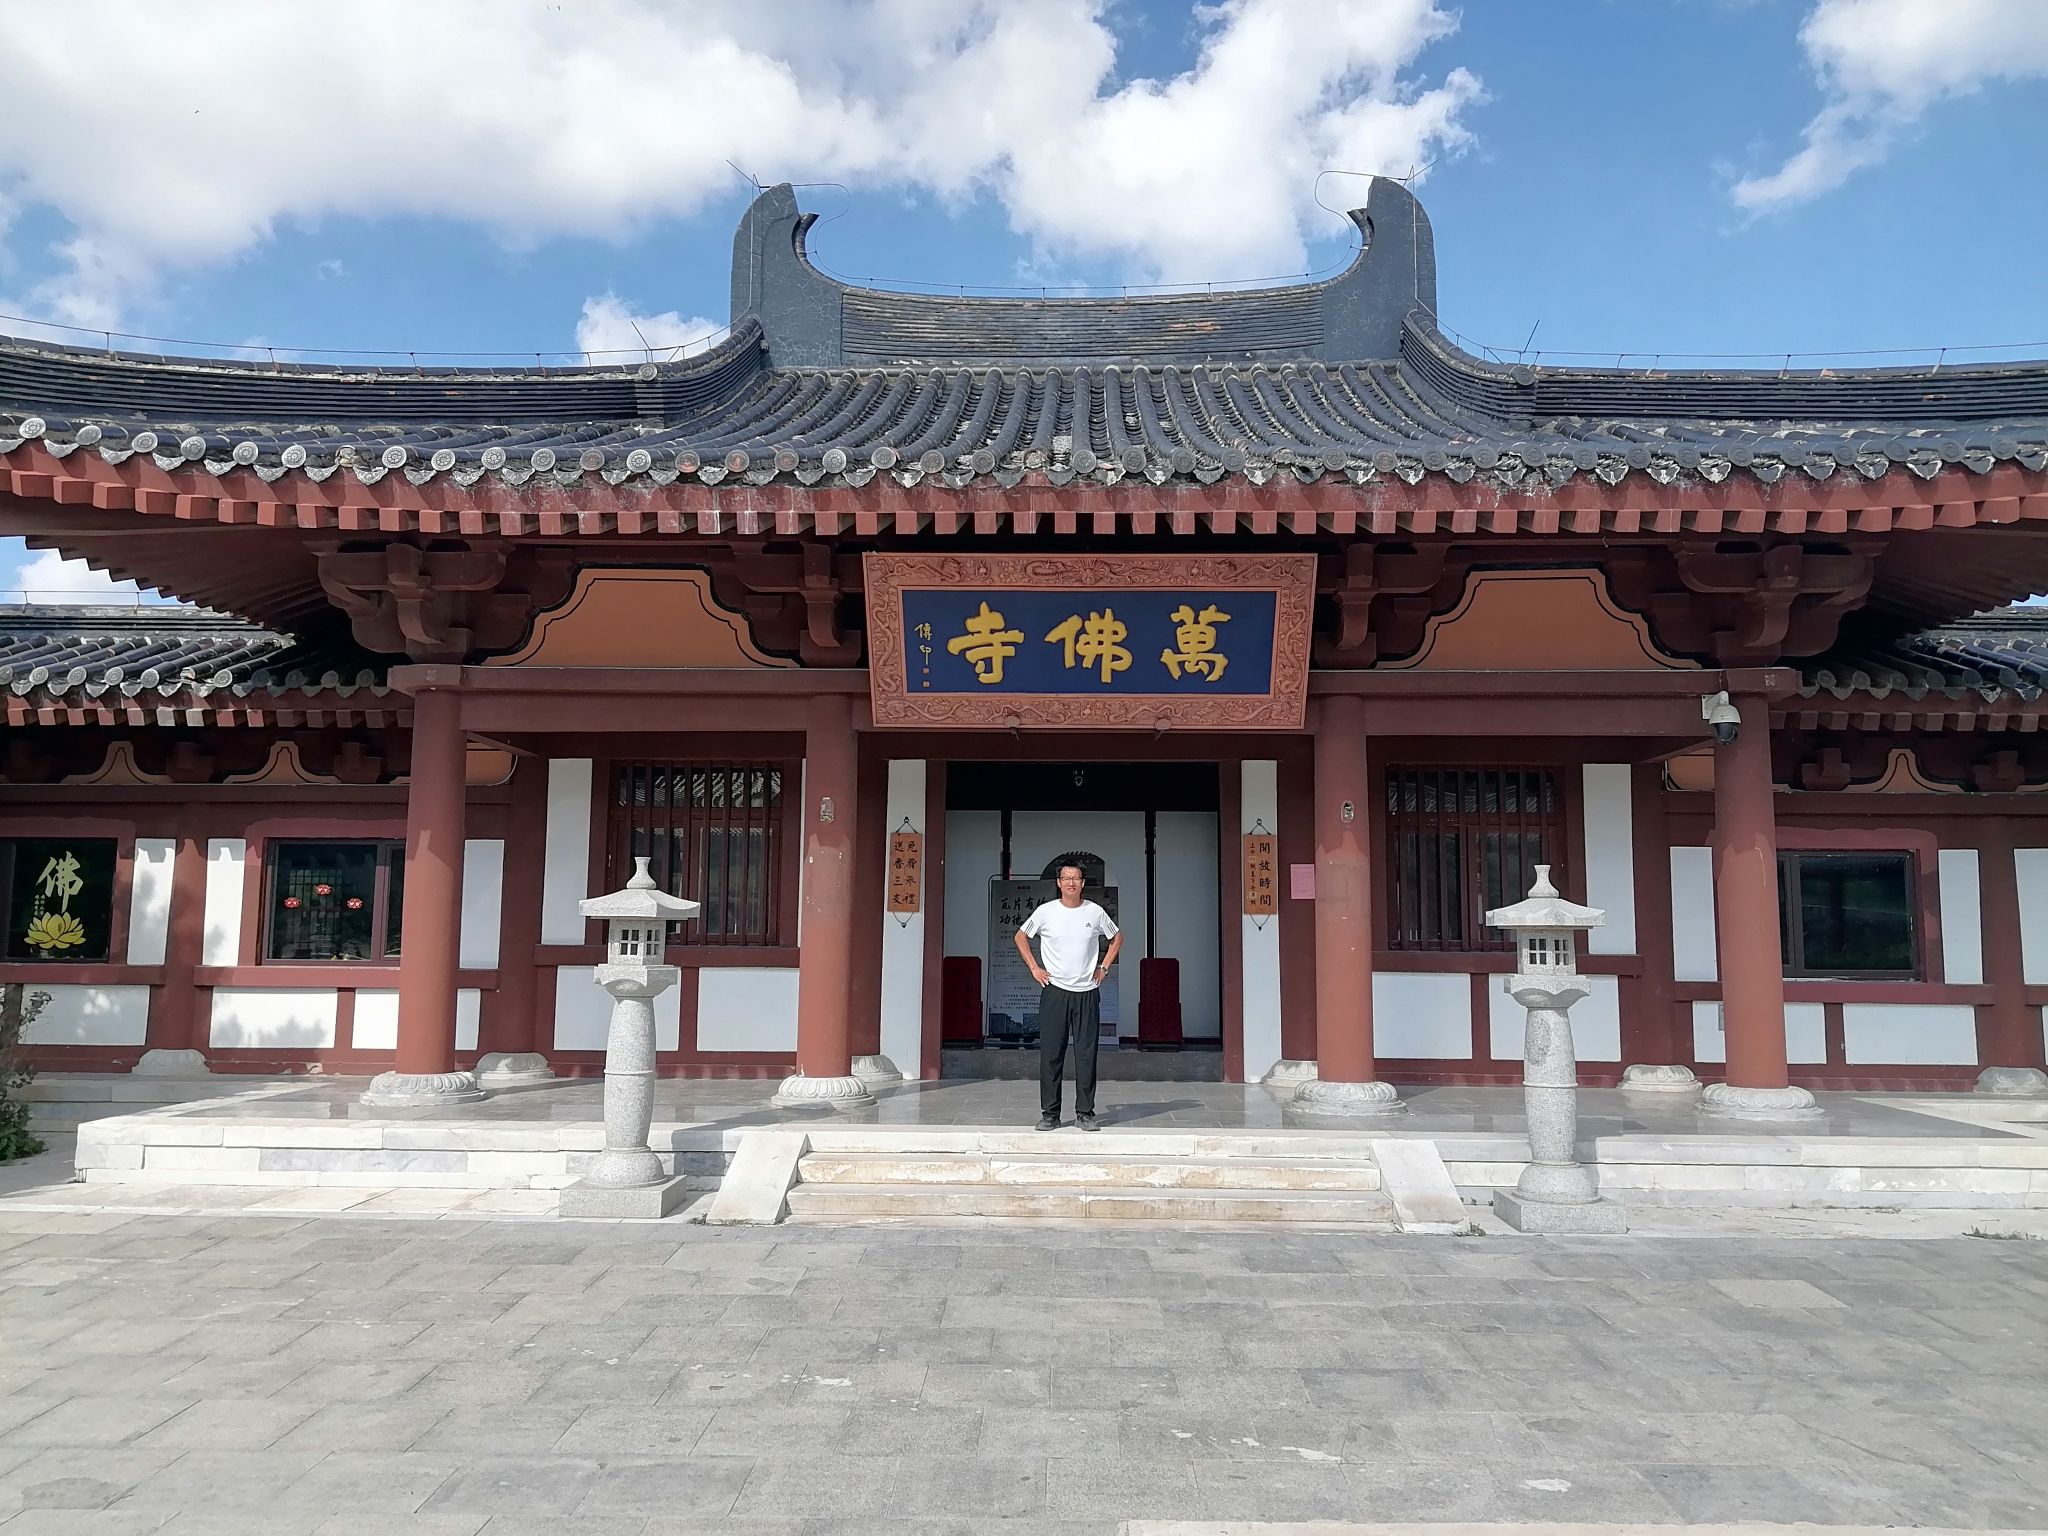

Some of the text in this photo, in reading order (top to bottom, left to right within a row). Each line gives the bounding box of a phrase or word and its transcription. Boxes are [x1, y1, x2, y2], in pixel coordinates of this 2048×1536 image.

[946, 601, 1231, 684] 萬佛寺
[35, 850, 84, 914] 佛
[1259, 842, 1272, 907] 開放時間
